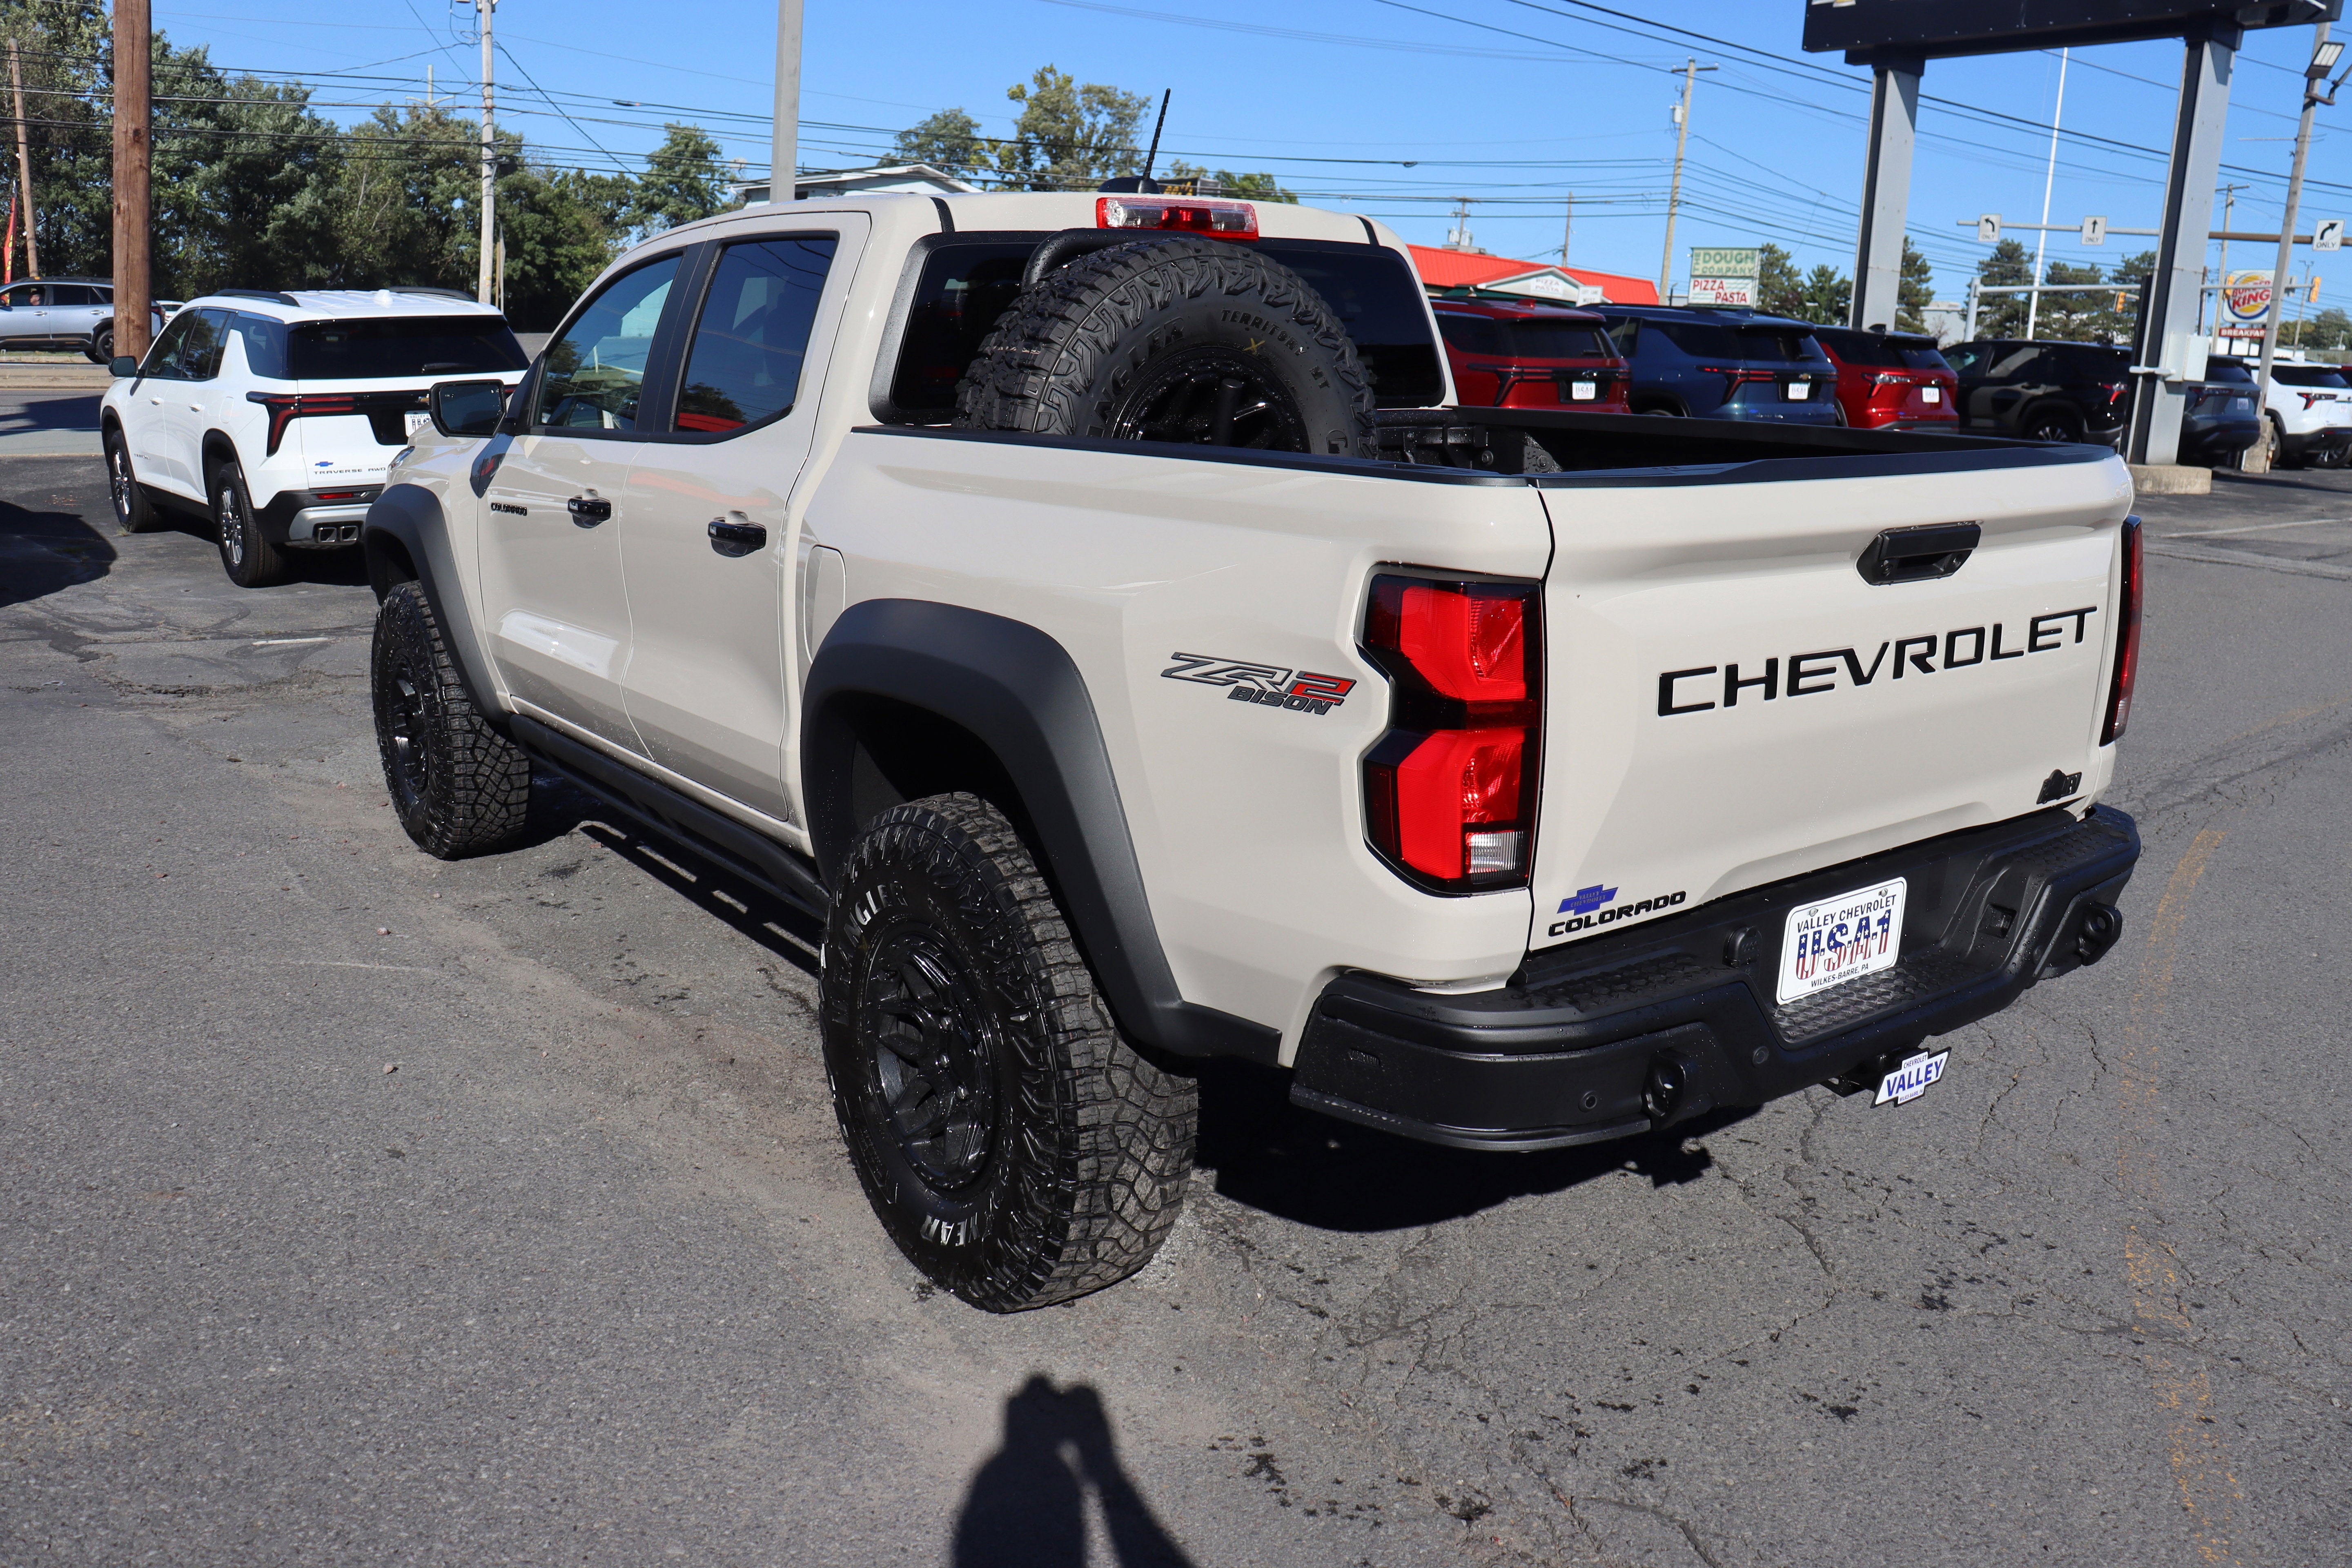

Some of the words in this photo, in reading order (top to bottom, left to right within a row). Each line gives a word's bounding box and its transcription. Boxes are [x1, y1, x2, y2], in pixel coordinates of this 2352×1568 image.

[1703, 252, 1755, 263] DOUGH
[1693, 280, 1724, 290] PIZZA
[1715, 292, 1747, 303] PASTA
[2232, 289, 2271, 311] KING
[1221, 308, 1307, 356] TERRITORY
[1657, 606, 2097, 717] CHEVROLET
[1160, 652, 1357, 706] ZR2
[1227, 686, 1334, 715] BISON
[1548, 891, 1686, 937] COLORADO
[1797, 912, 1836, 933] VALLEY
[1839, 894, 1897, 921] CHEVROLET
[1861, 963, 1869, 971] PA
[1903, 1054, 1927, 1069] CHEVROLET
[1886, 1058, 1944, 1097] VALLEY
